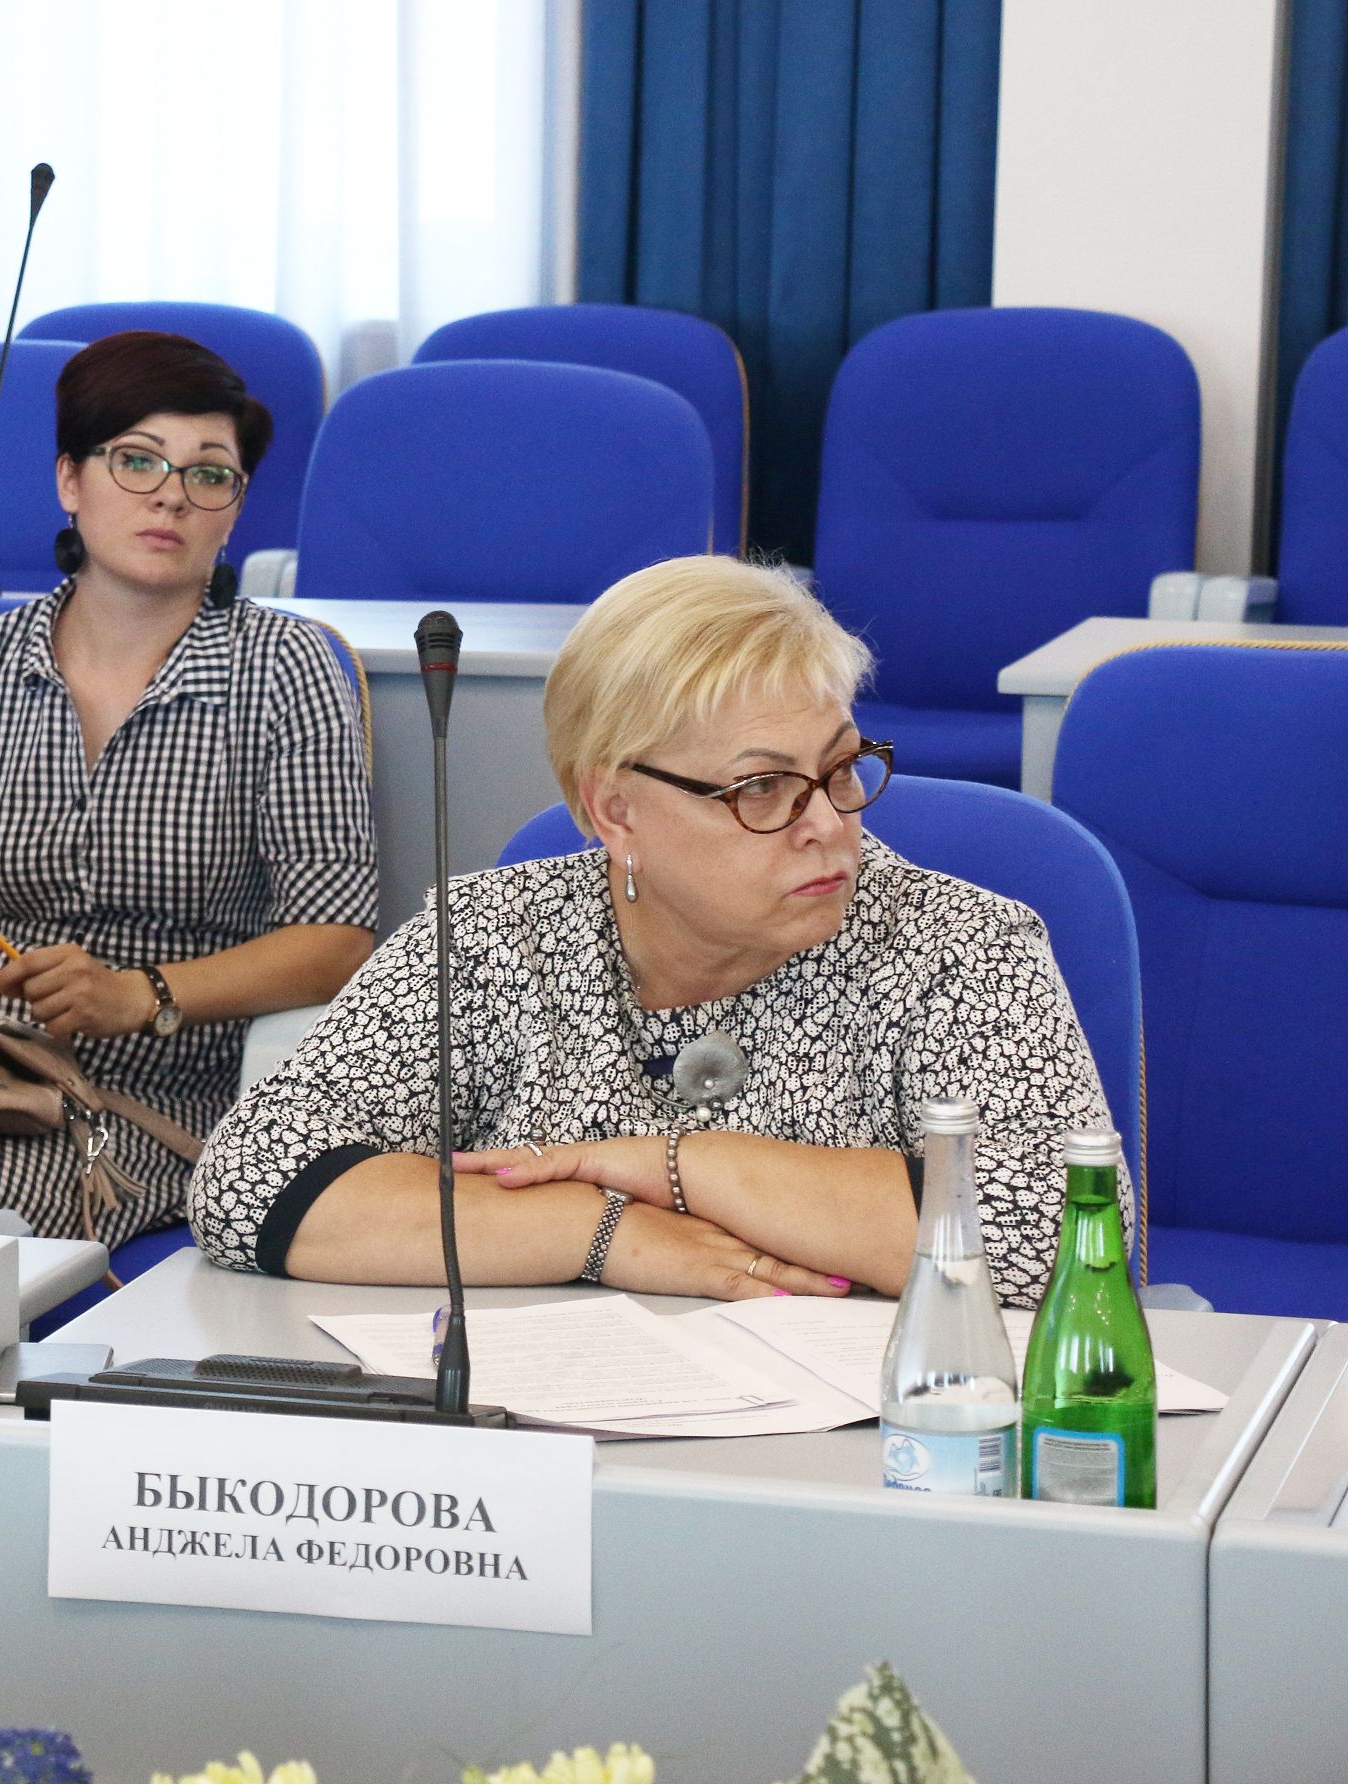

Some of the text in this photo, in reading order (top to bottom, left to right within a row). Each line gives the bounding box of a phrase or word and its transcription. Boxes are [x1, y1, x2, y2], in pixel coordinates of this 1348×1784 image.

[134, 1471, 498, 1534] БЫКОДОРОВА
[101, 1524, 530, 1582] АНДЖЕЛА ФЕДОРОВНА
